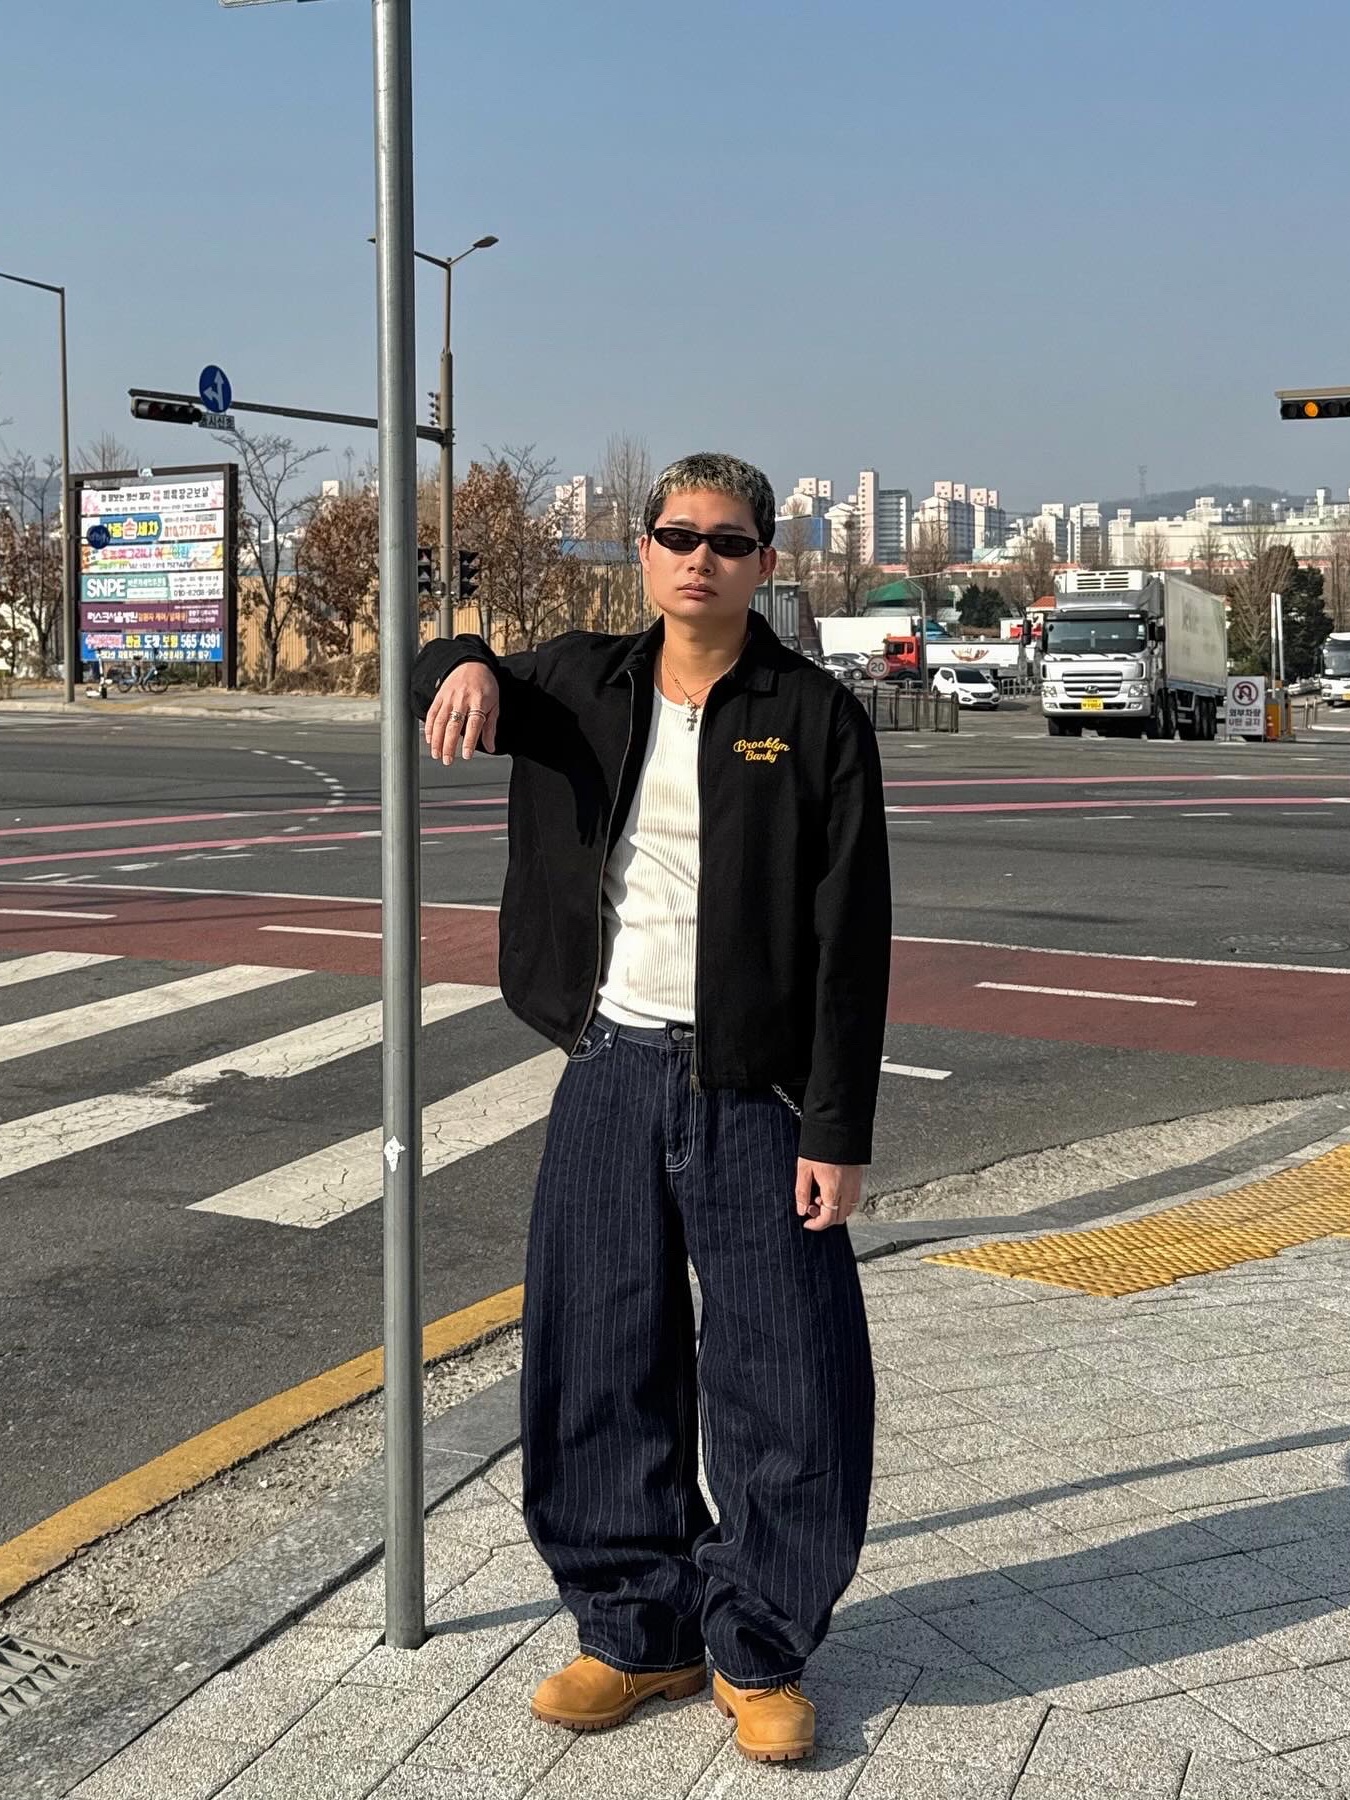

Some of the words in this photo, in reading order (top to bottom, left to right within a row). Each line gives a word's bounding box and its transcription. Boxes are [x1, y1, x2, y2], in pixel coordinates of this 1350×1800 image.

[87, 579, 126, 598] SNPE
[871, 662, 885, 672] 20
[1229, 708, 1261, 717] 외부차량
[1229, 718, 1242, 726] U턴
[733, 737, 790, 752] Brooklyn
[745, 749, 778, 764] Banky
